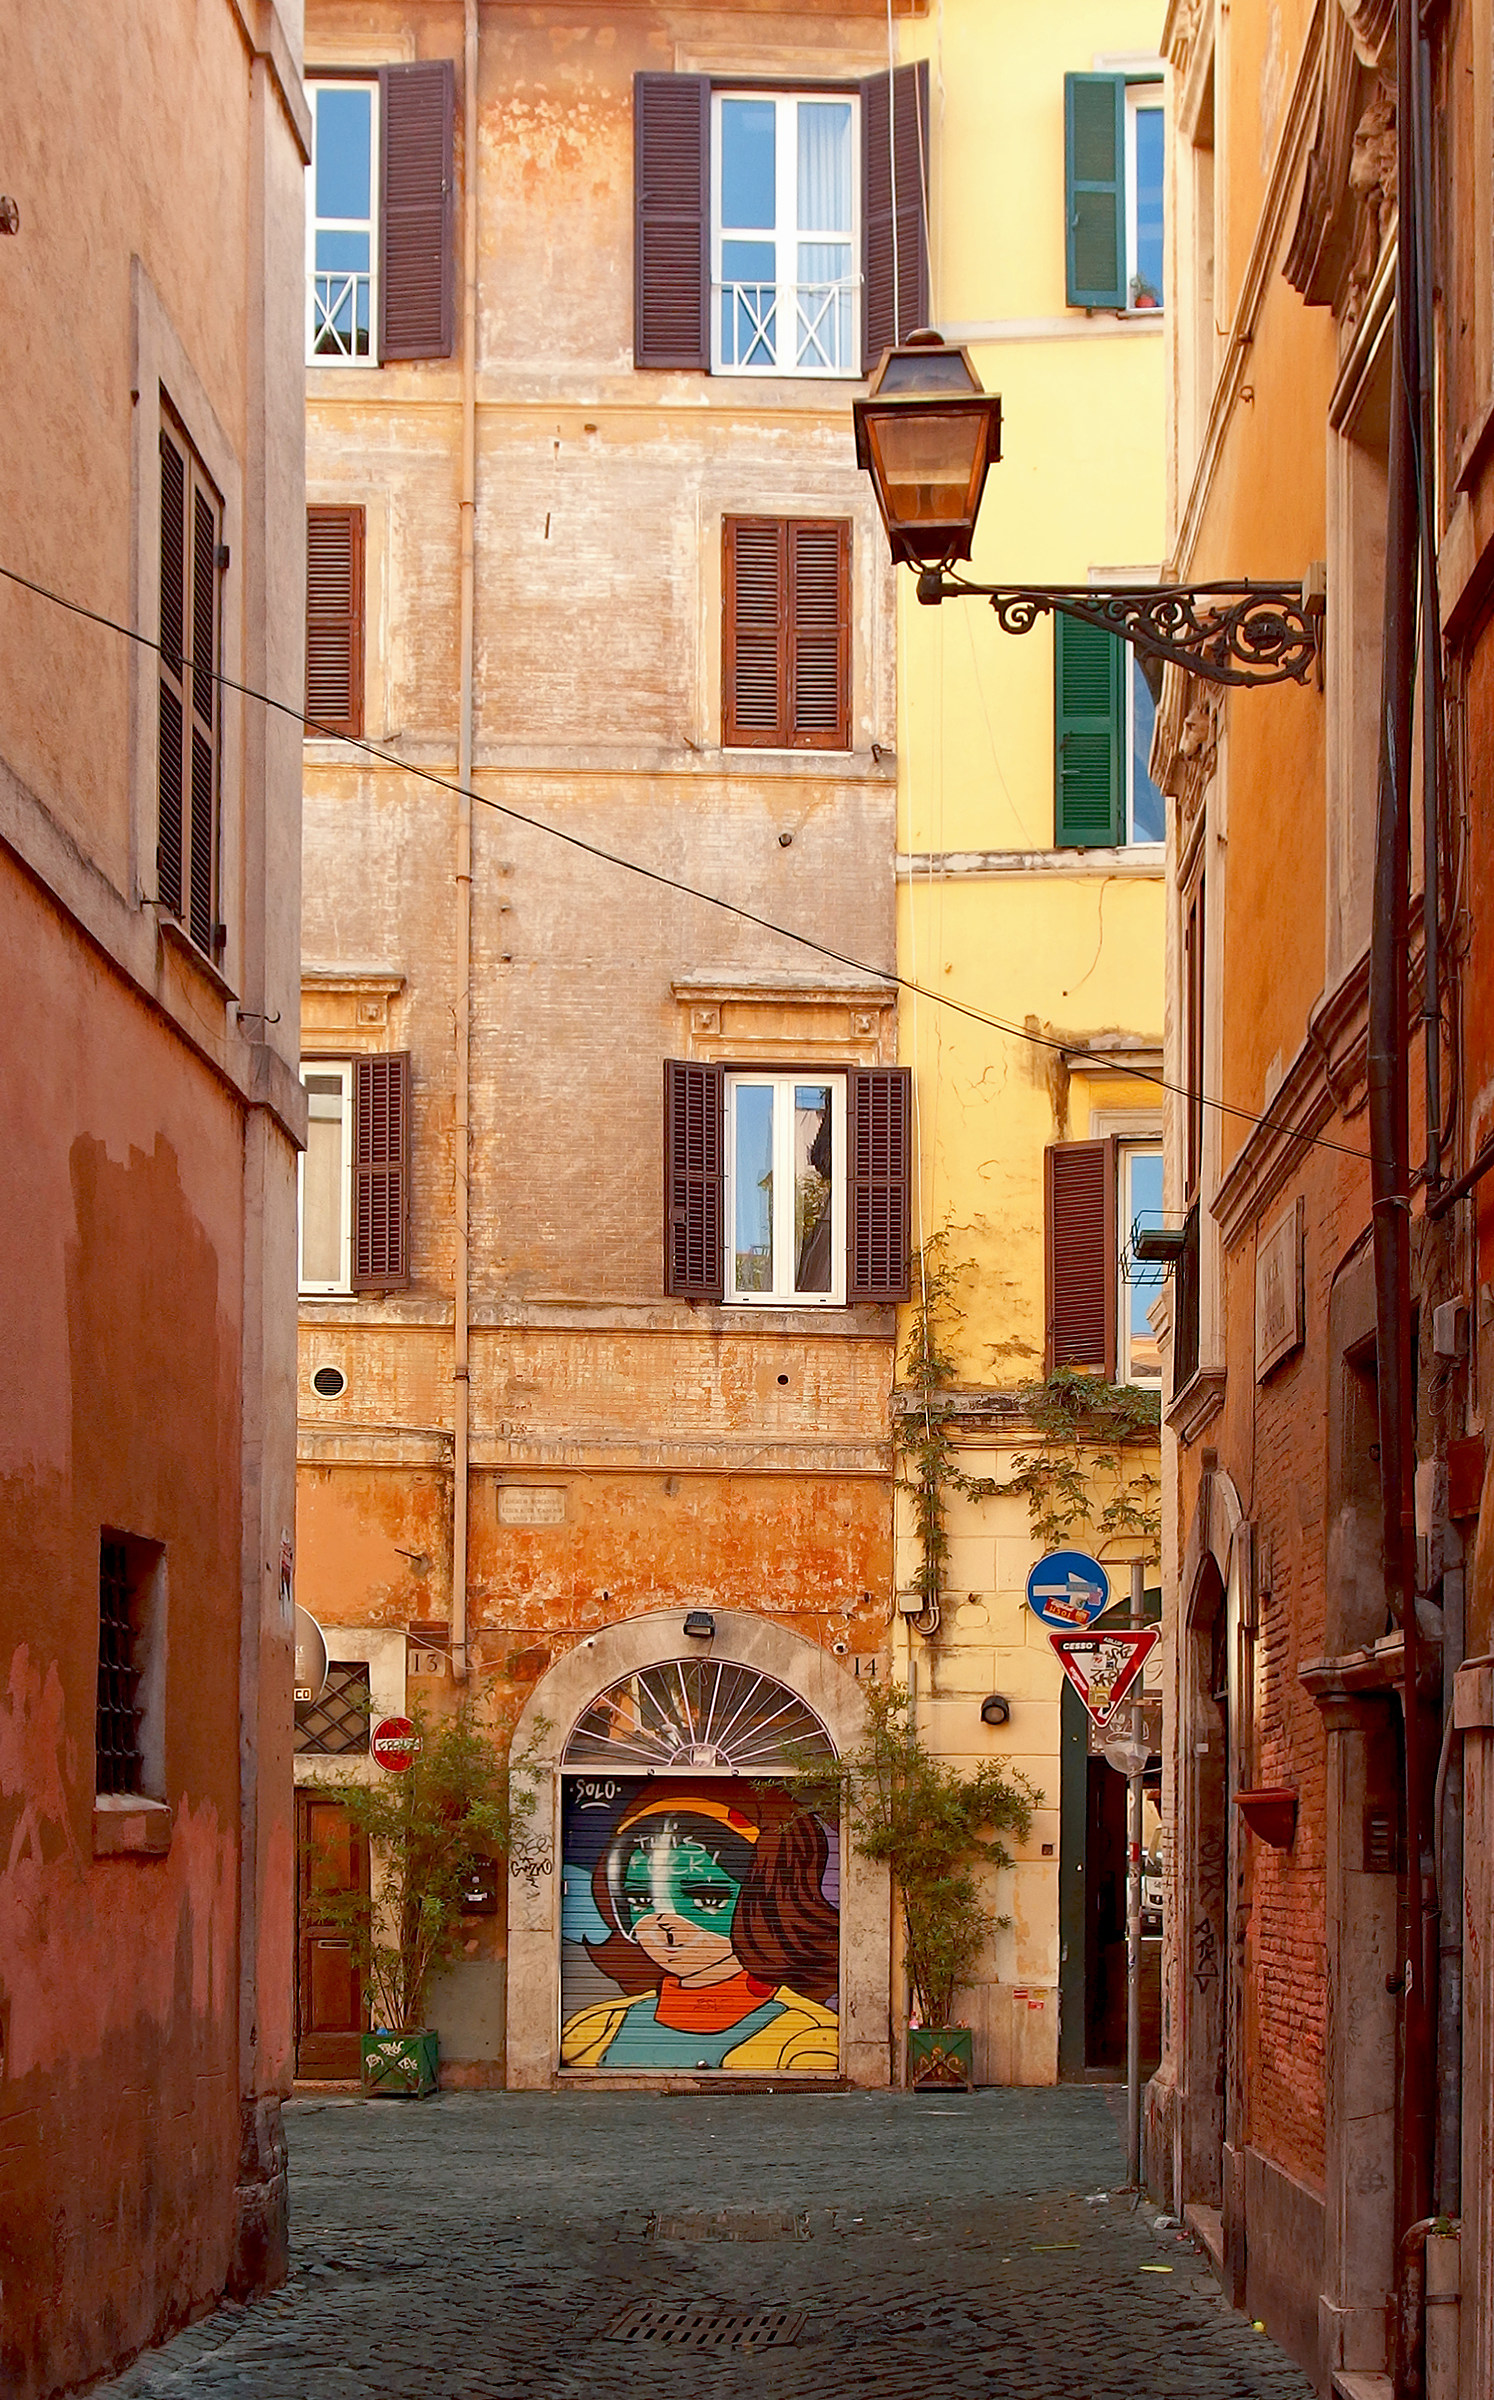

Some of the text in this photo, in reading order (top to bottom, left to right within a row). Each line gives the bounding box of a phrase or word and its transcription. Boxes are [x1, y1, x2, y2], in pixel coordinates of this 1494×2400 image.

[1063, 1642, 1094, 1650] CESSO
[415, 1653, 437, 1672] 13
[855, 1657, 878, 1675] 14
